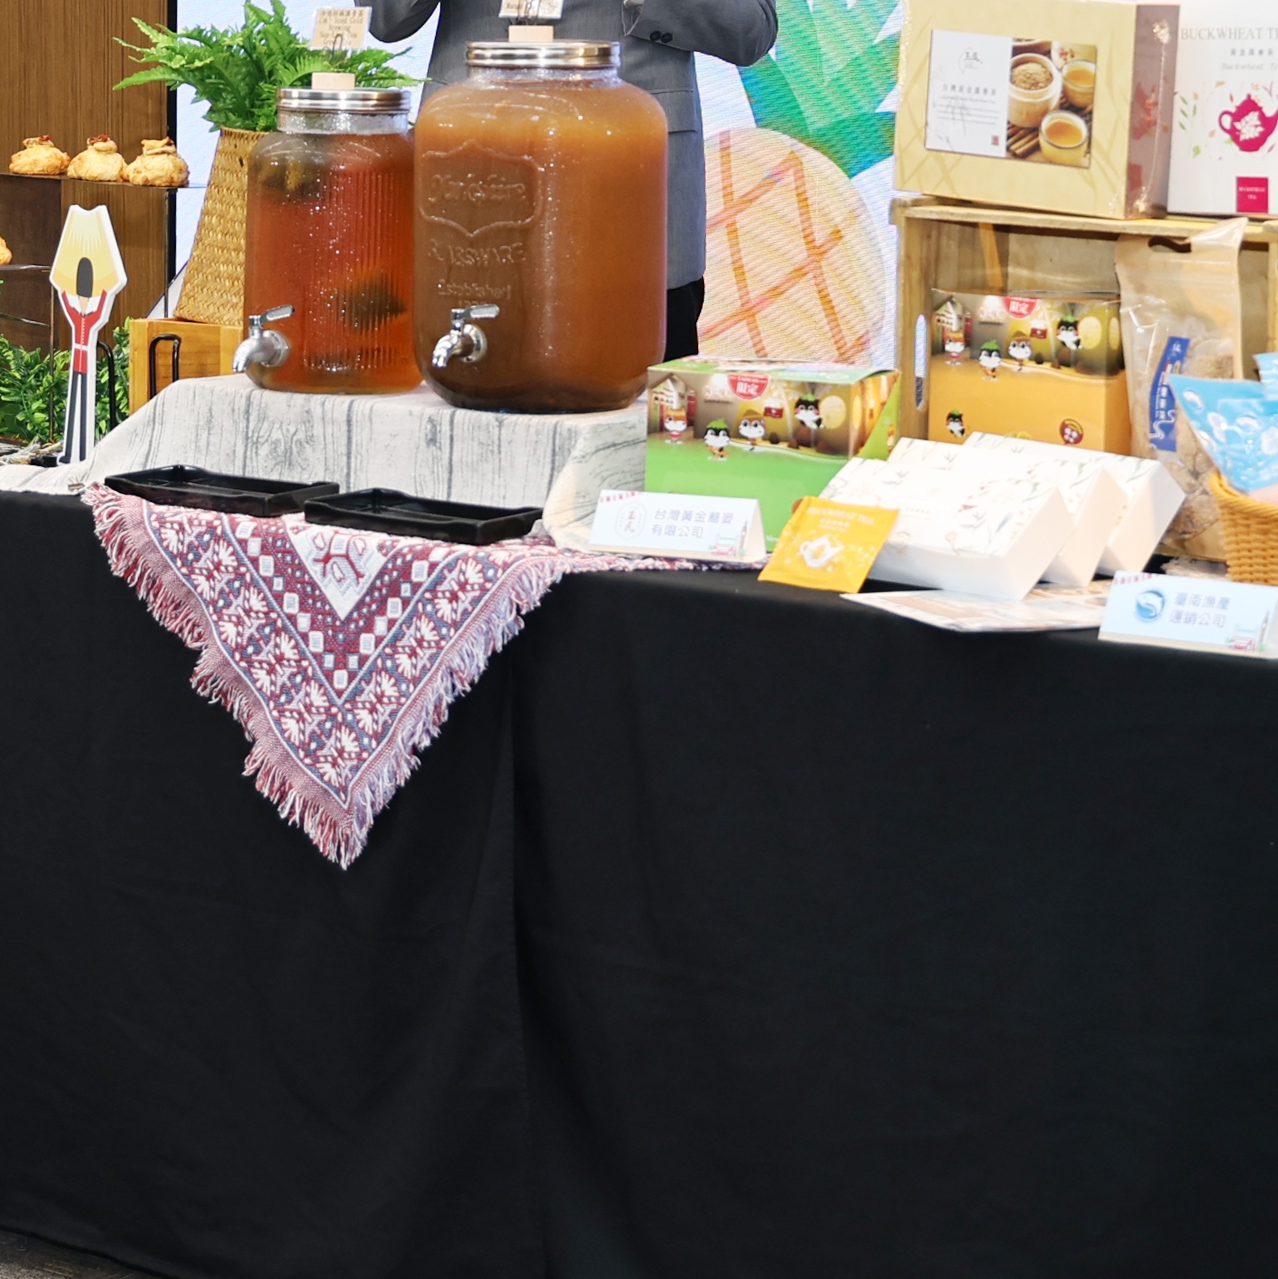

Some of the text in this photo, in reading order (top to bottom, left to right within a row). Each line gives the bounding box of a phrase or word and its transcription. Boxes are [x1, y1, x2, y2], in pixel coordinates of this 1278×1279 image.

[1180, 27, 1263, 41] BUCKWHEAT
[651, 525, 705, 539] 有限公司
